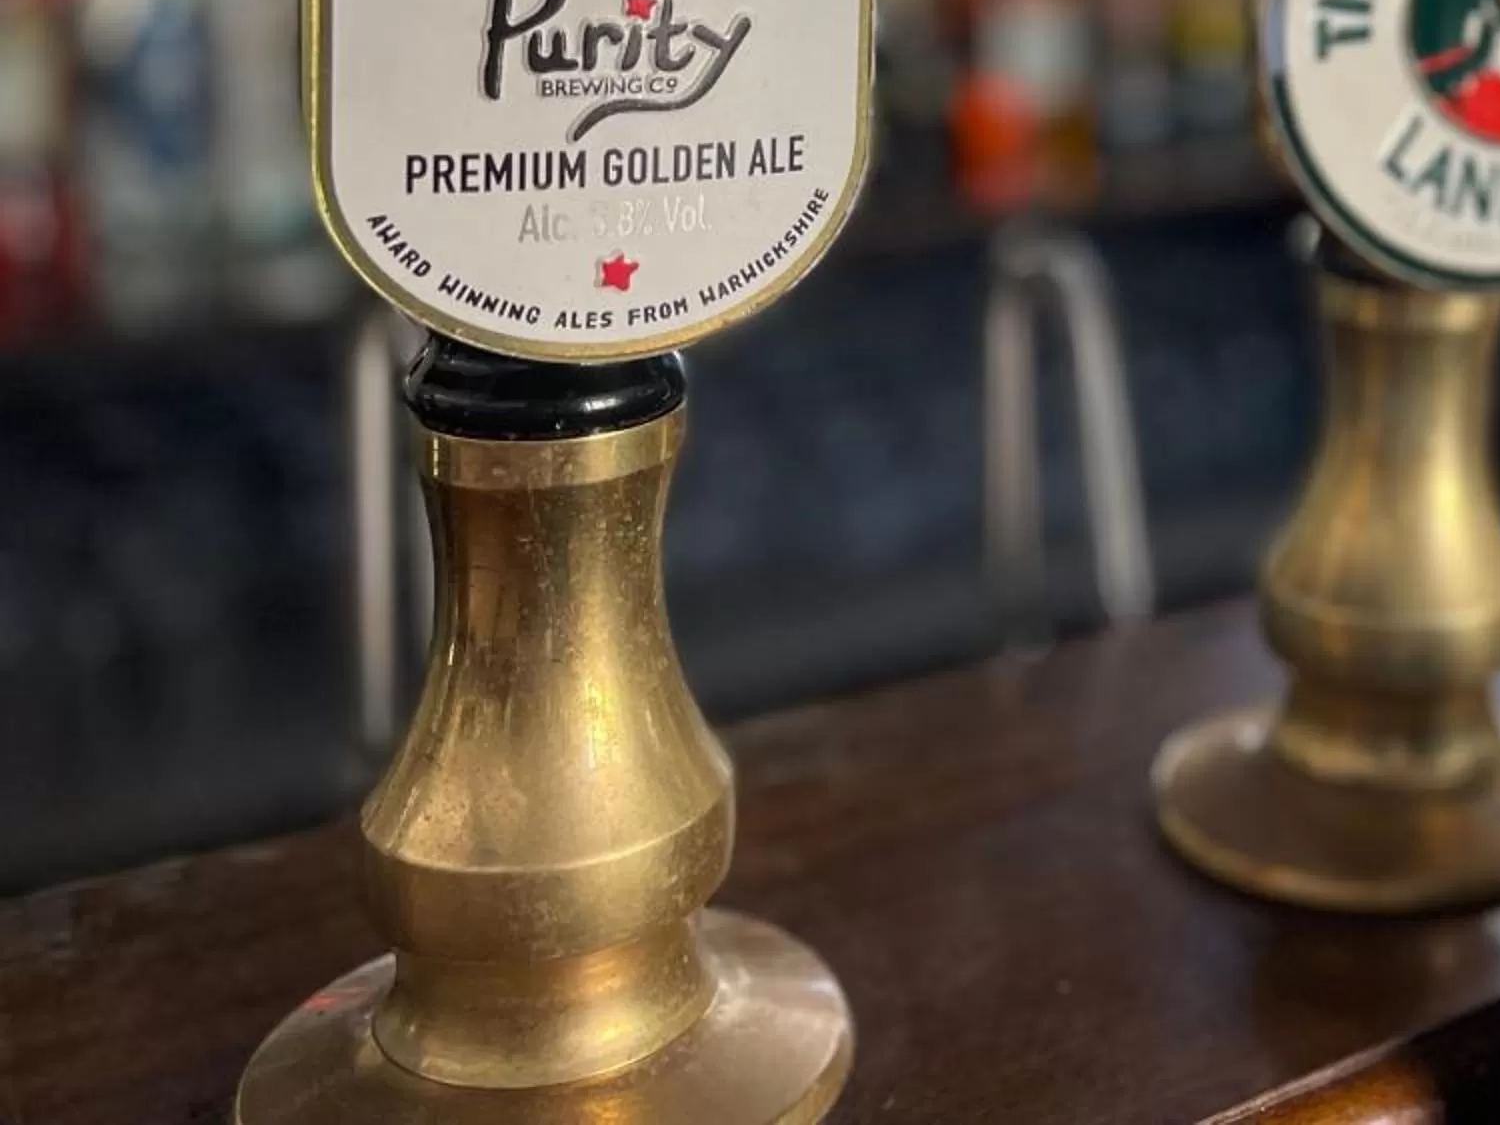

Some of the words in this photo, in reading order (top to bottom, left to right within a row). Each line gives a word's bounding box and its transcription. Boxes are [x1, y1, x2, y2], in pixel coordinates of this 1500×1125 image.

[541, 78, 643, 97] BREWING
[406, 151, 586, 194] PREMIUM
[603, 141, 736, 187] GOLDEN
[748, 135, 805, 174] ALE
[663, 193, 713, 234] Vol.
[366, 213, 431, 279] AWARD
[438, 274, 542, 325] WINNING
[554, 310, 613, 330] ALES
[627, 297, 690, 326] FROM
[699, 186, 830, 306] WARWICKSHIRE
